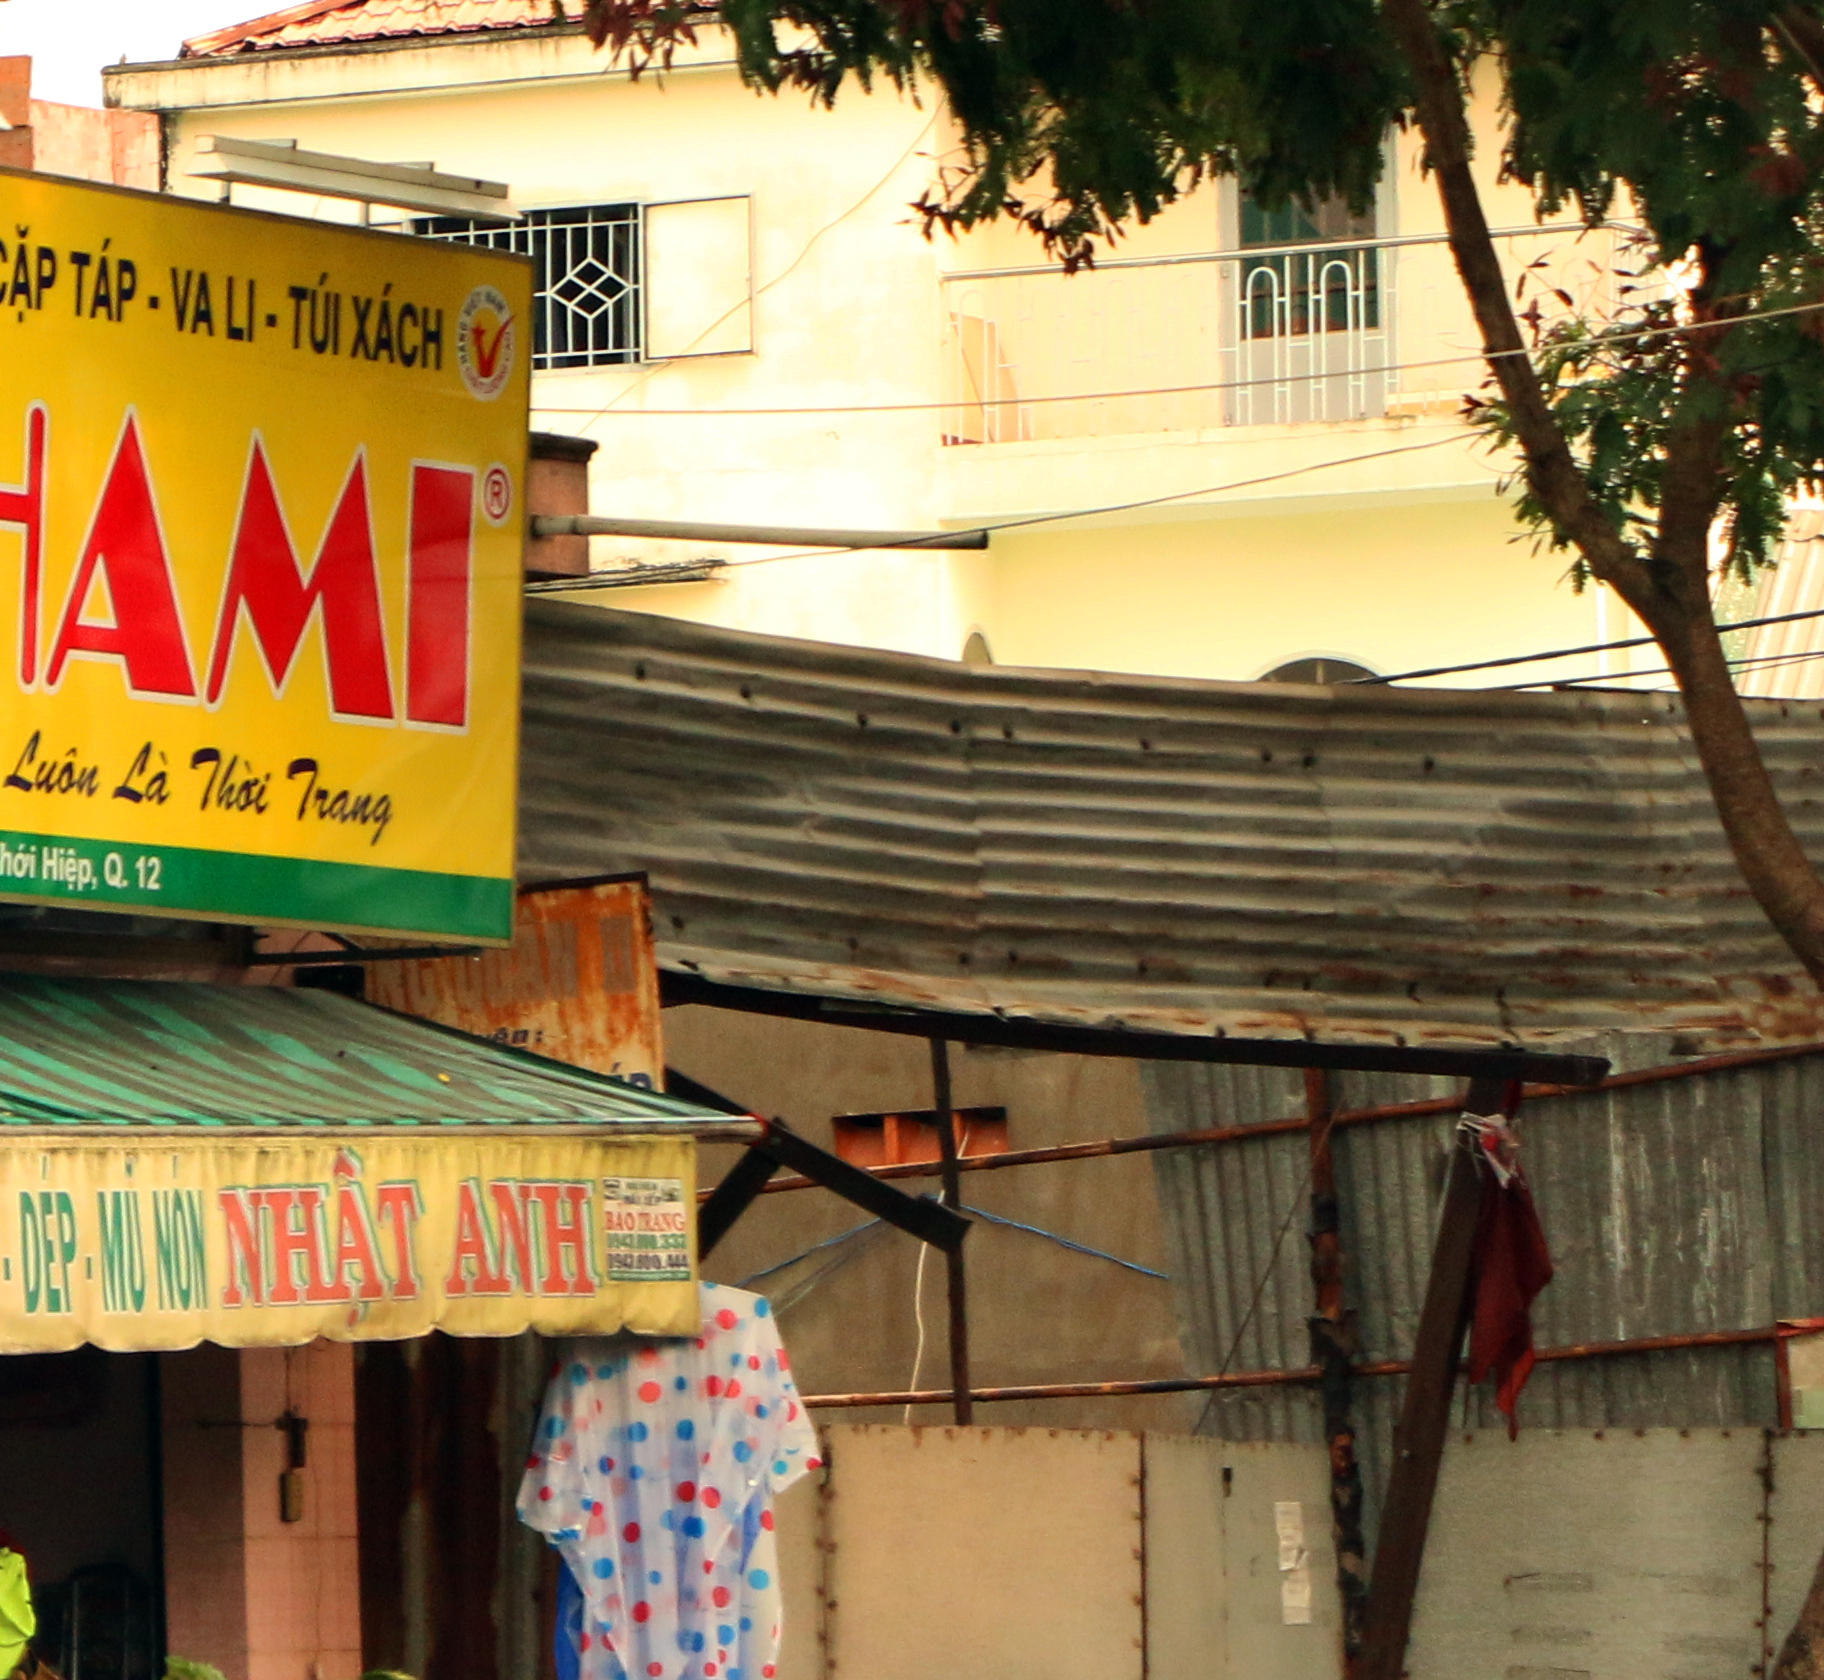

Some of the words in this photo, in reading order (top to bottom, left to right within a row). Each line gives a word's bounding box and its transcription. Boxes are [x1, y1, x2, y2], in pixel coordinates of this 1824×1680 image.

[69, 237, 137, 322] TÁP
[170, 266, 214, 337] VA
[226, 275, 256, 343] LI
[288, 271, 341, 356] TÚI
[349, 282, 444, 372] XÁCH
[2, 729, 100, 798] Luôn
[112, 740, 170, 806] Là
[190, 746, 272, 816] Thời
[287, 757, 393, 847] Trang
[41, 846, 99, 892] Hiệp,
[103, 851, 129, 889] Q.
[135, 854, 164, 892] 12
[19, 1155, 77, 1314] DÉP
[153, 1154, 209, 1312] NÓN
[218, 1146, 425, 1327] NHẬT
[445, 1177, 603, 1300] ANH
